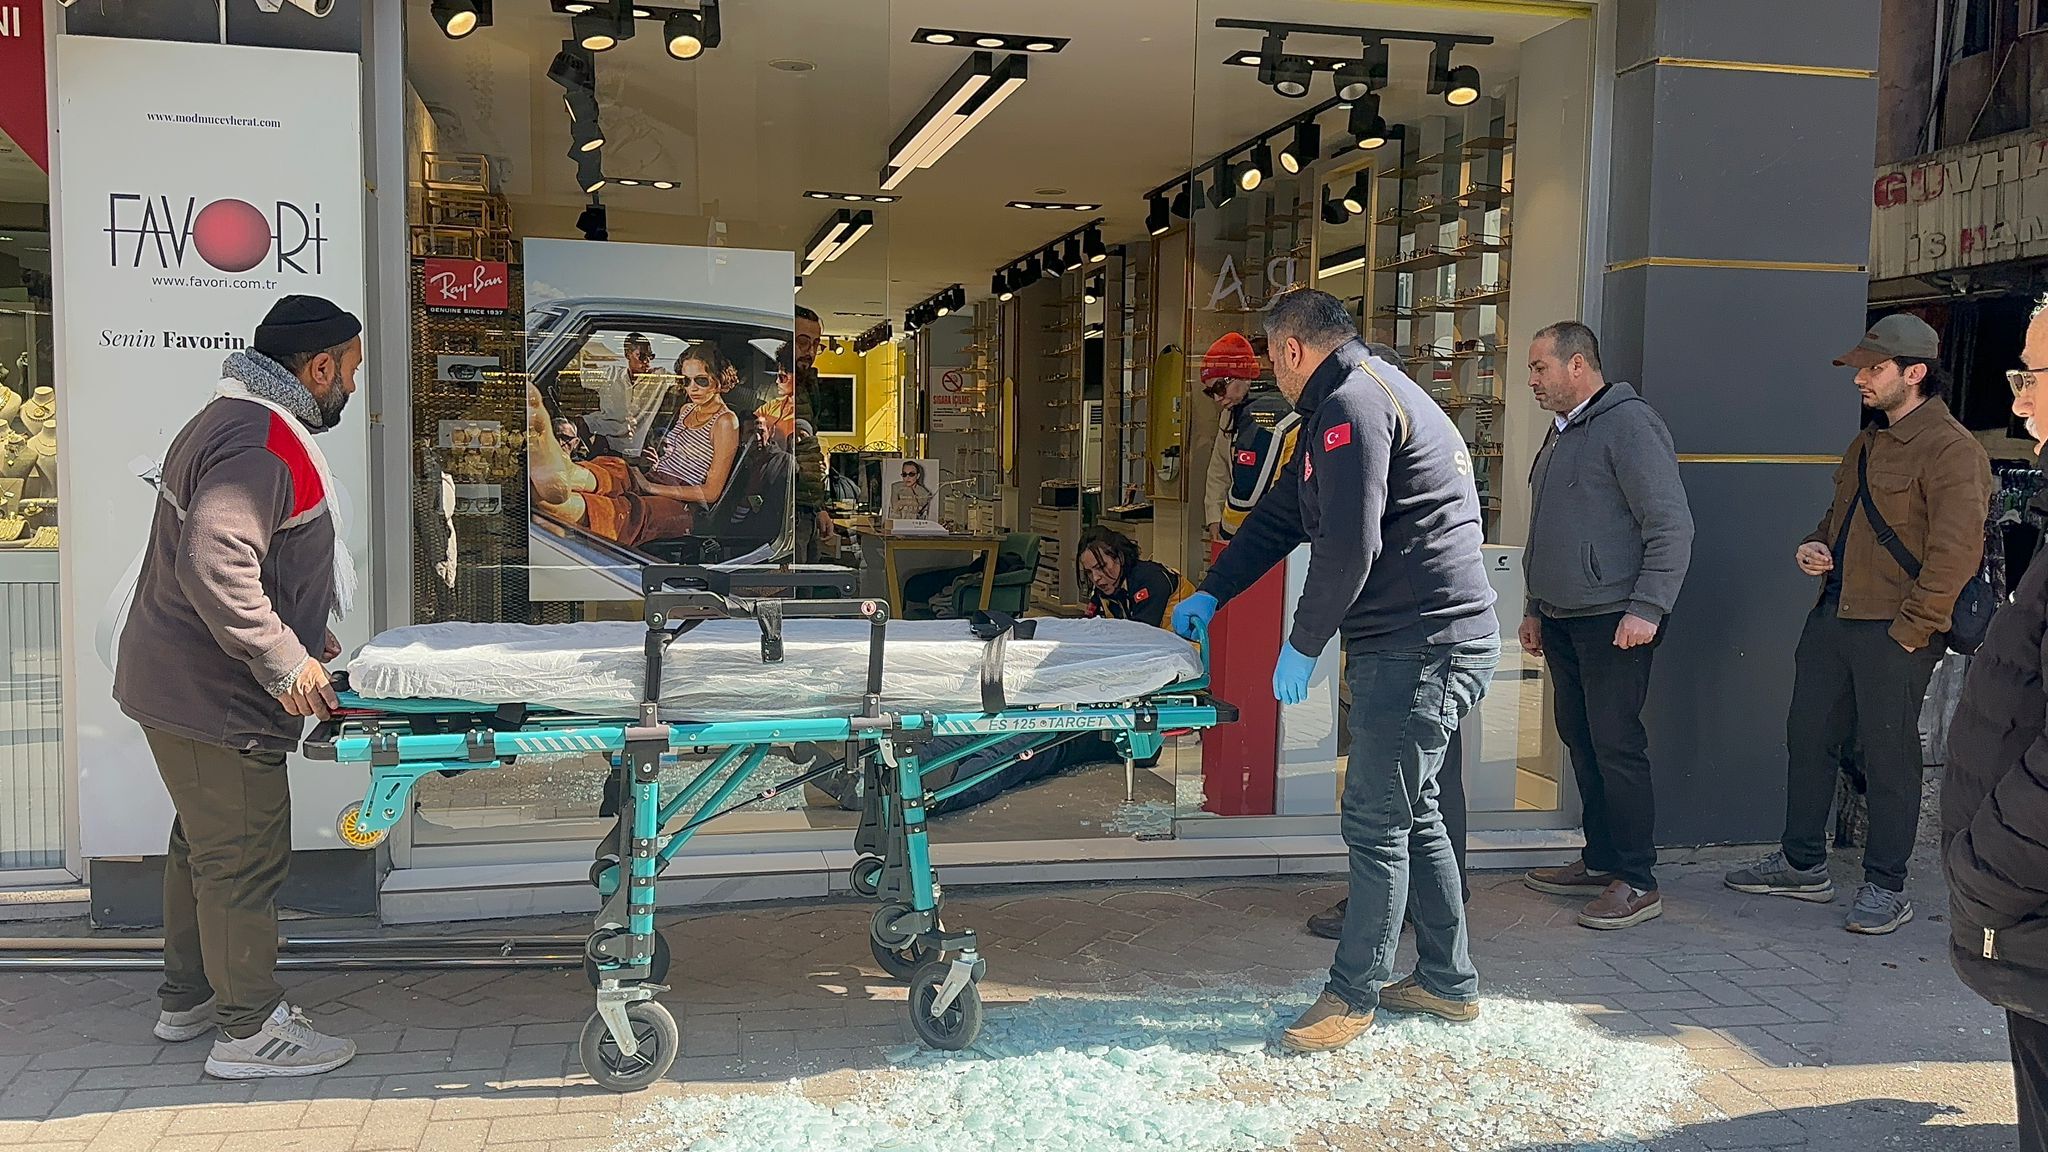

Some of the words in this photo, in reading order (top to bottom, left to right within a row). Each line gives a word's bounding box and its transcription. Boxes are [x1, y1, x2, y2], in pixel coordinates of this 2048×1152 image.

[147, 112, 281, 128] www.modmucevherat.com
[152, 276, 277, 290] www.favori.com.tr
[430, 265, 503, 301] Ray-Ban
[99, 329, 156, 348] Senin
[162, 331, 245, 350] Favorin
[989, 719, 1007, 731] ES
[1012, 718, 1036, 730] 125
[1048, 716, 1106, 729] TARGET
